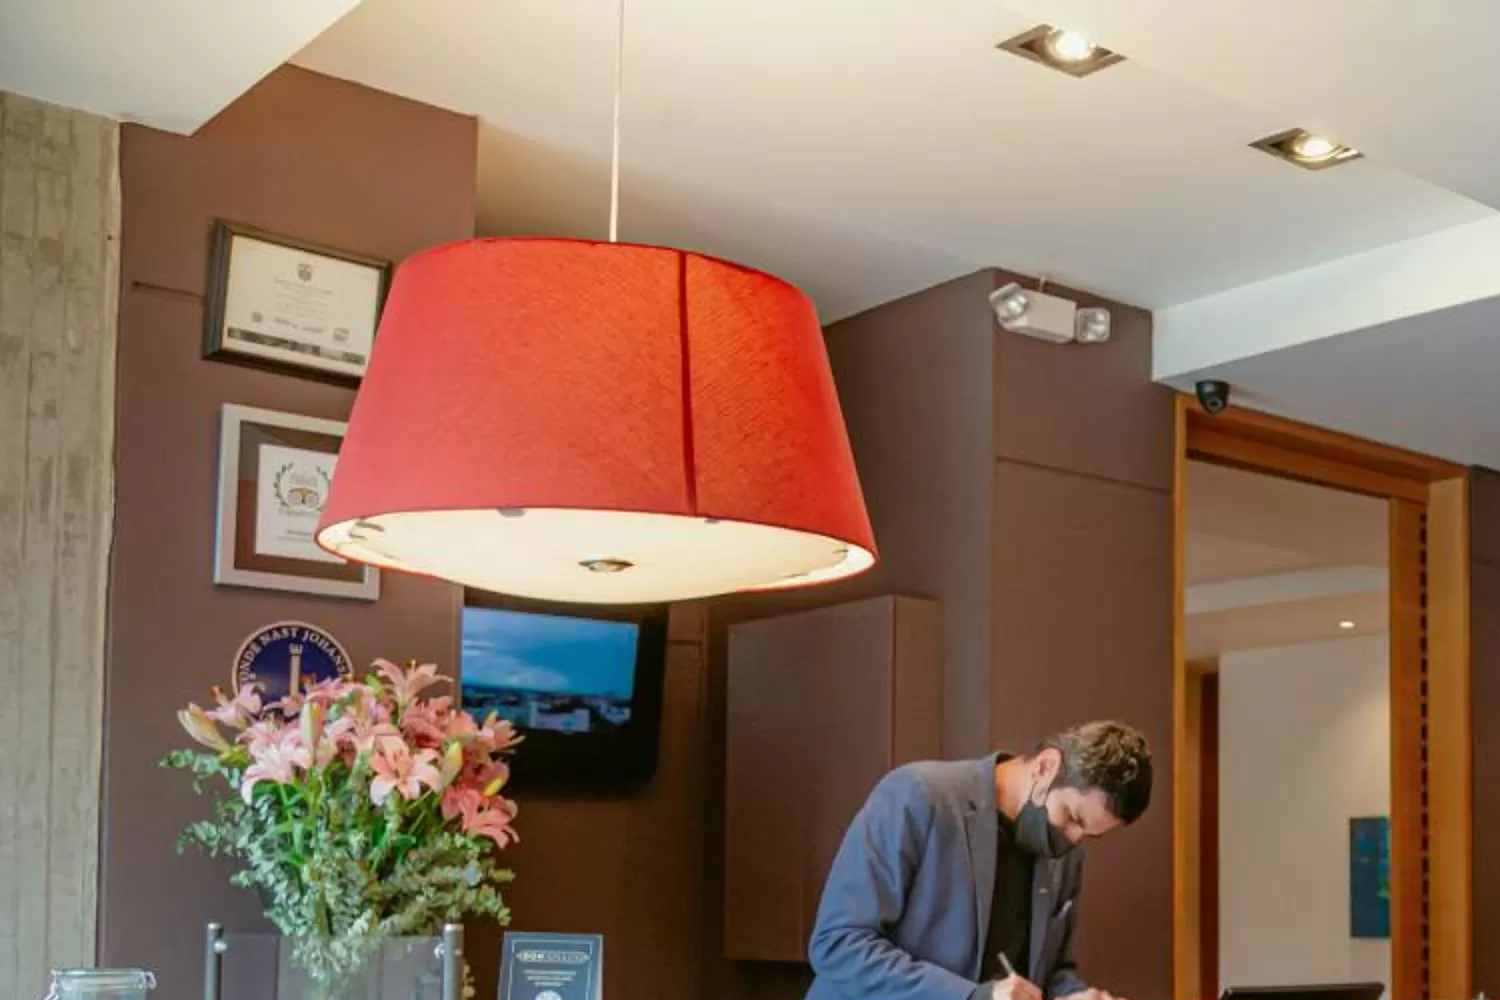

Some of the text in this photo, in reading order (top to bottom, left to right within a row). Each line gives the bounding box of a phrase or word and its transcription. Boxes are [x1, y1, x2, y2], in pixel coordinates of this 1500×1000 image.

[239, 627, 347, 683] ONDE NAST JOHANS
